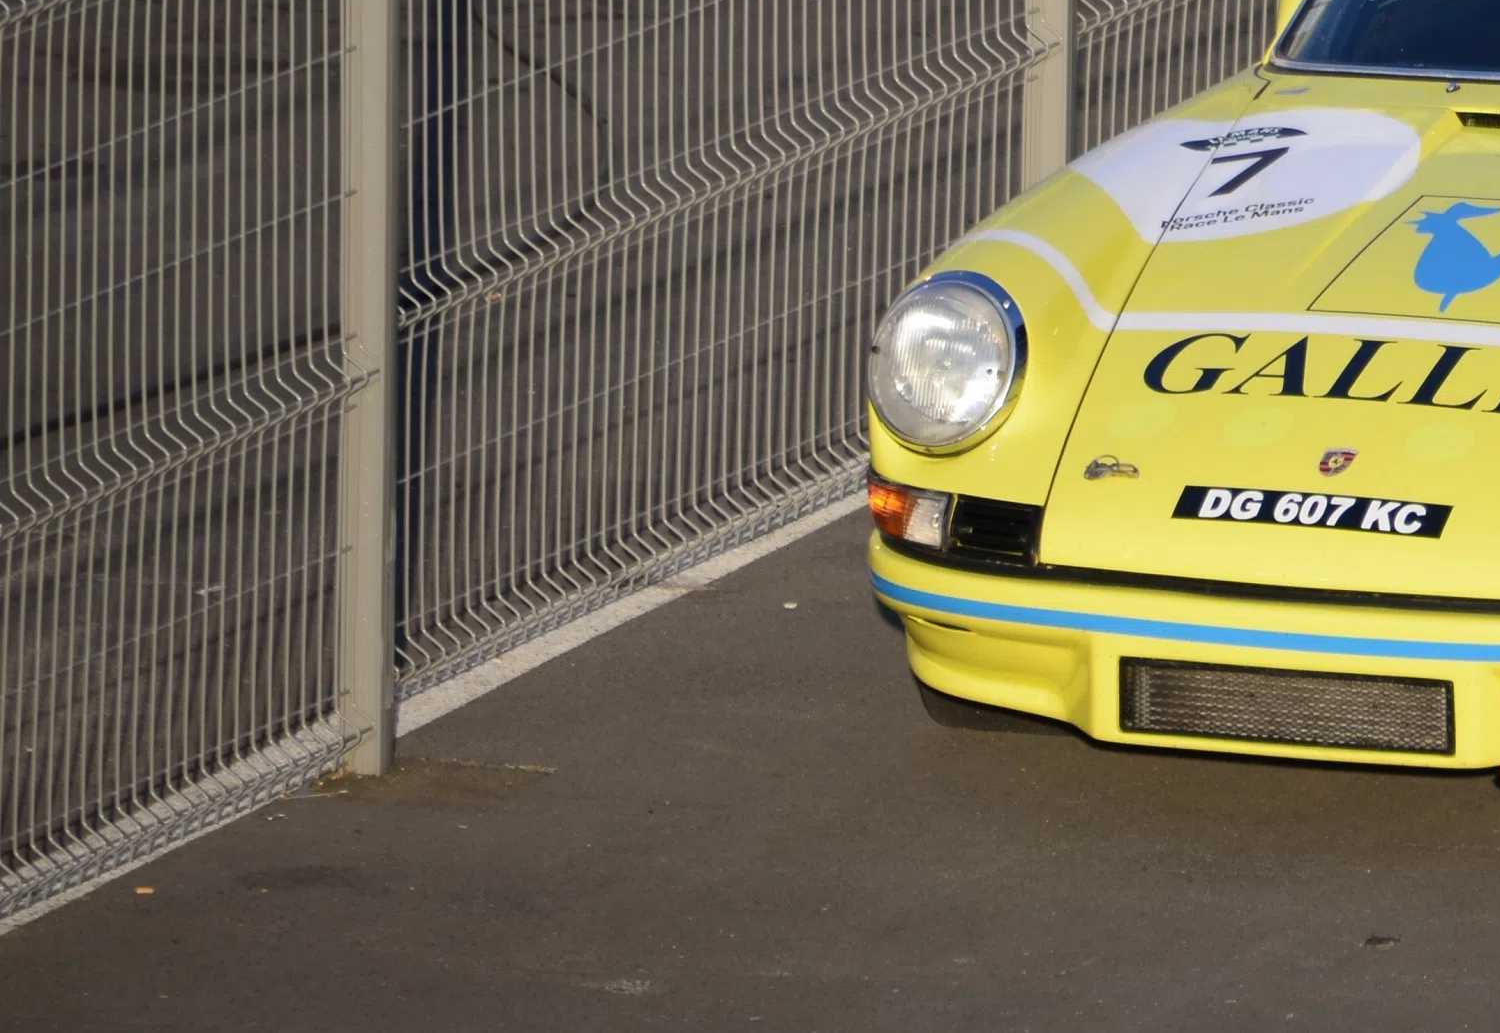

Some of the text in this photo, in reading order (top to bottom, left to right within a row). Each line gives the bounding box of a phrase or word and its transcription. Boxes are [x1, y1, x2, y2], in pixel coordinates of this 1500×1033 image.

[1208, 146, 1290, 197] 7
[1161, 198, 1315, 229] Porsche Classic
[1169, 206, 1304, 232] Race Le Mans
[1198, 488, 1429, 535] DG 607 KC
